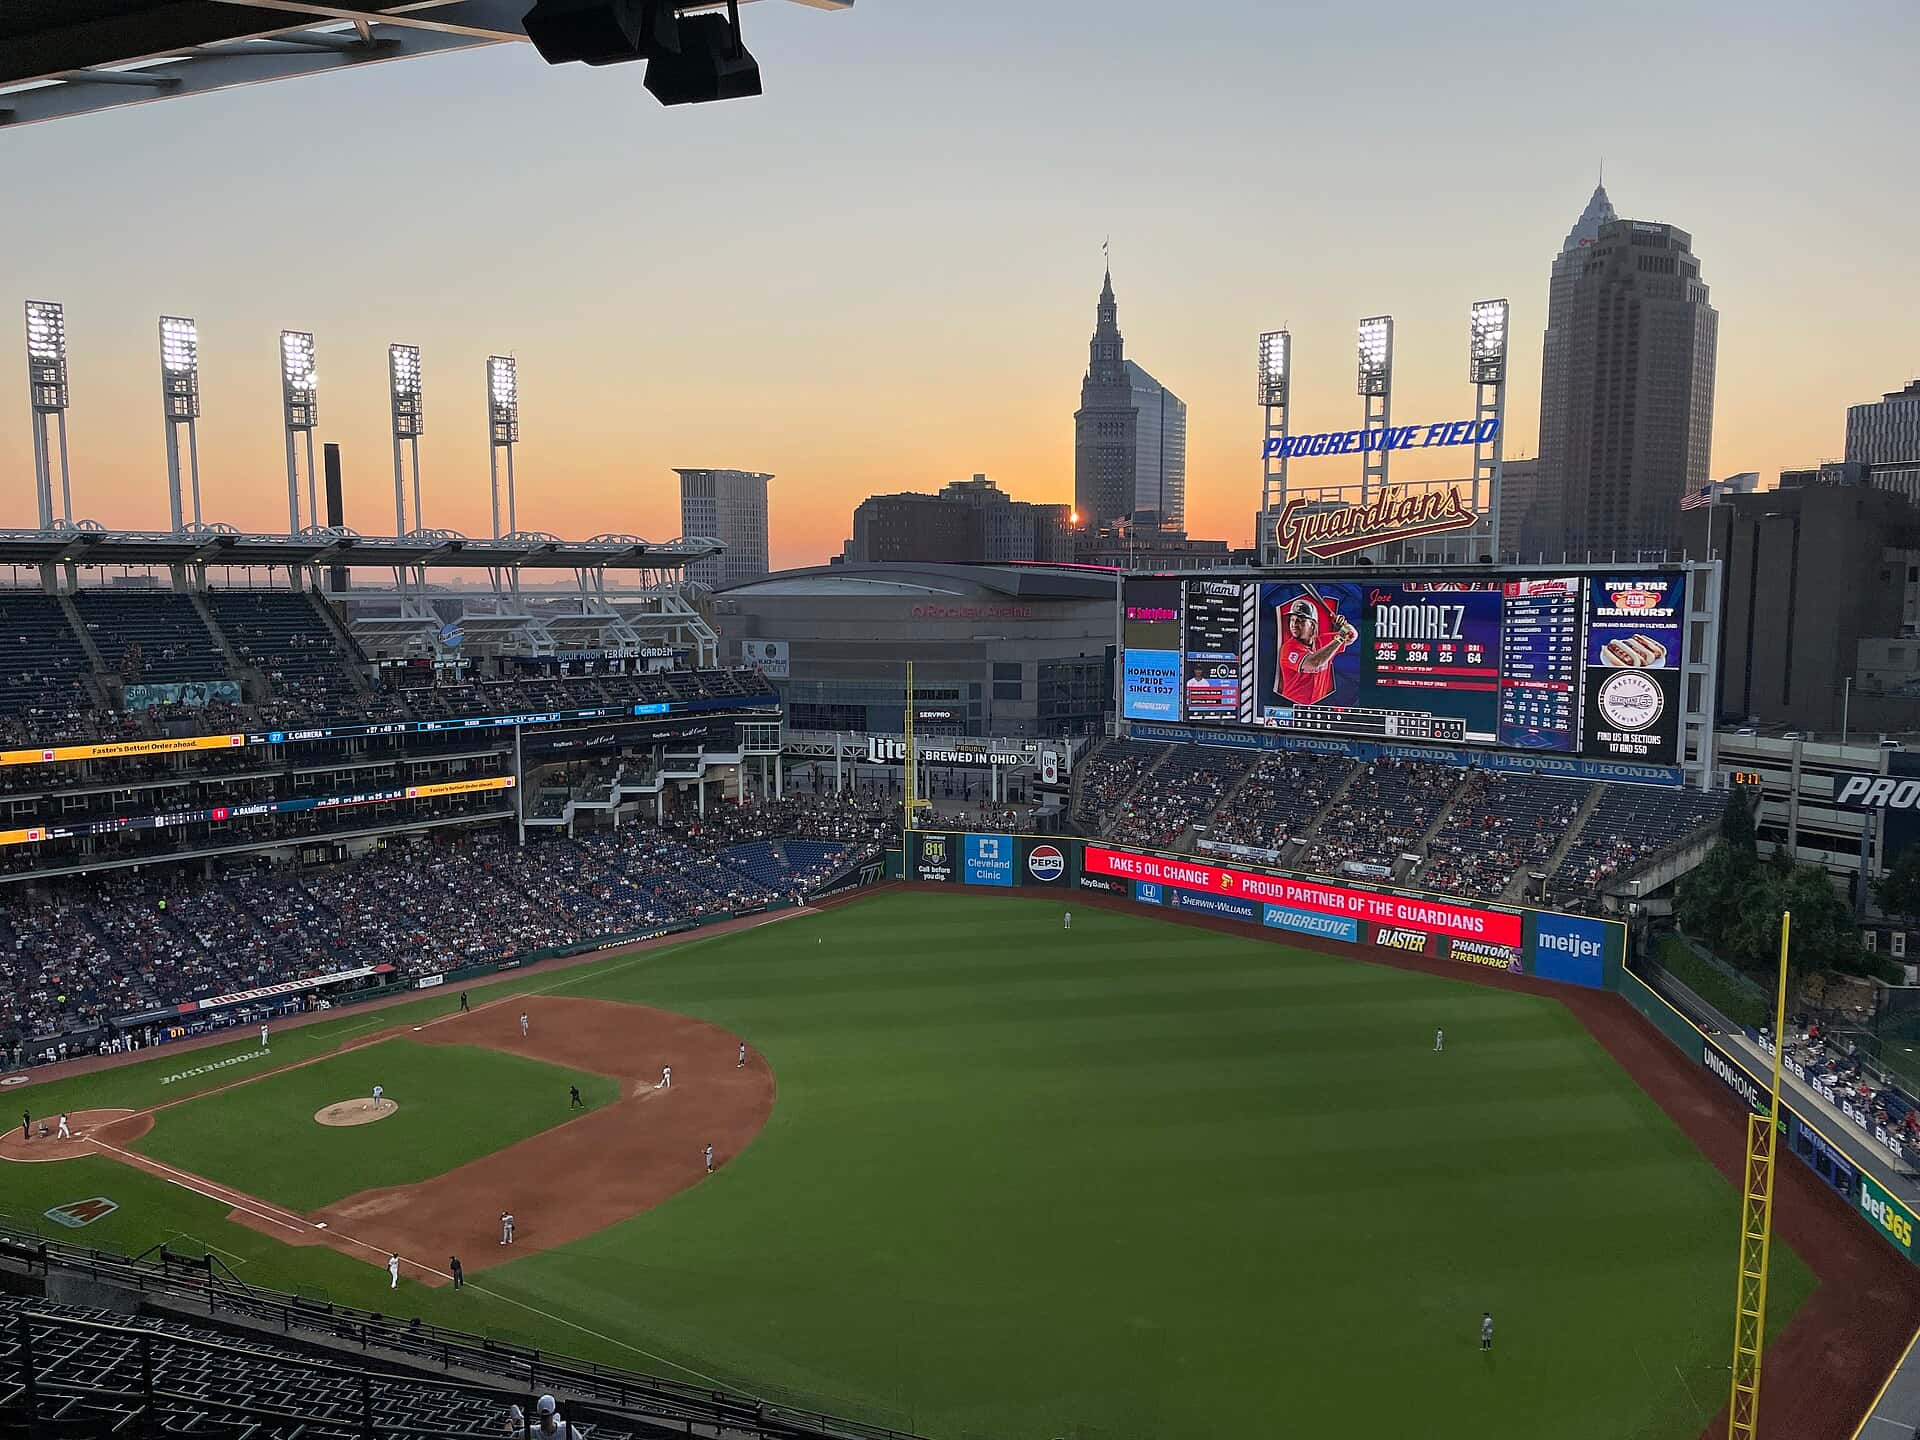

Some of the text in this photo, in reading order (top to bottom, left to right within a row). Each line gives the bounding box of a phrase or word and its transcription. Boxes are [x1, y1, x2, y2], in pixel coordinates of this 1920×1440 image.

[1262, 418, 1500, 460] PROGRESSIVE FIELD
[1276, 485, 1478, 562] Guardians
[1605, 582, 1668, 591] FIVE STAR
[1375, 597, 1465, 640] RAMÍREZ
[1597, 607, 1674, 617] BRATWURST
[603, 647, 673, 659] TERRACE GARDEN
[1376, 650, 1482, 663] .295 .894 25 64
[1128, 667, 1176, 677] HOMETOWN
[1140, 677, 1163, 685] PRIDE
[1129, 685, 1174, 695] SINCE 1937
[1147, 728, 1192, 739] HONDA
[1207, 732, 1257, 744] HONDA
[1613, 732, 1621, 742] US
[1631, 734, 1662, 744] SECTIONS
[151, 742, 172, 750] Order
[867, 737, 906, 764] Lite
[1296, 739, 1350, 751] HONDA
[1609, 743, 1619, 752] 117
[925, 751, 1018, 765] BREWED IN OHIO
[1397, 749, 1458, 761] HONDA
[1509, 757, 1577, 771] HONDA
[1600, 766, 1674, 780] HONDA
[1837, 776, 1920, 809] PRO
[217, 810, 224, 818] 11
[925, 842, 943, 857] 811
[967, 858, 1010, 869] Cleveland
[1031, 858, 1062, 868] PEPSI
[931, 866, 950, 874] before
[976, 870, 1001, 880] Clinic
[1108, 856, 1209, 885] TAKE 5 OIL CHANGE
[1080, 877, 1110, 890] KeyBank
[1242, 879, 1484, 933] PROUD PARTNER OF THE GUARDIANS
[1265, 909, 1352, 937] PROGRESSIVE
[1376, 928, 1427, 953] BLASTER
[1539, 933, 1601, 957] meijer
[1452, 939, 1510, 959] PHANTOM
[1450, 950, 1509, 969] FIREWORKS
[160, 1048, 272, 1085] PROGRESSIVE
[1704, 1047, 1758, 1109] UNIONHOME
[1861, 1182, 1912, 1247] bet365
